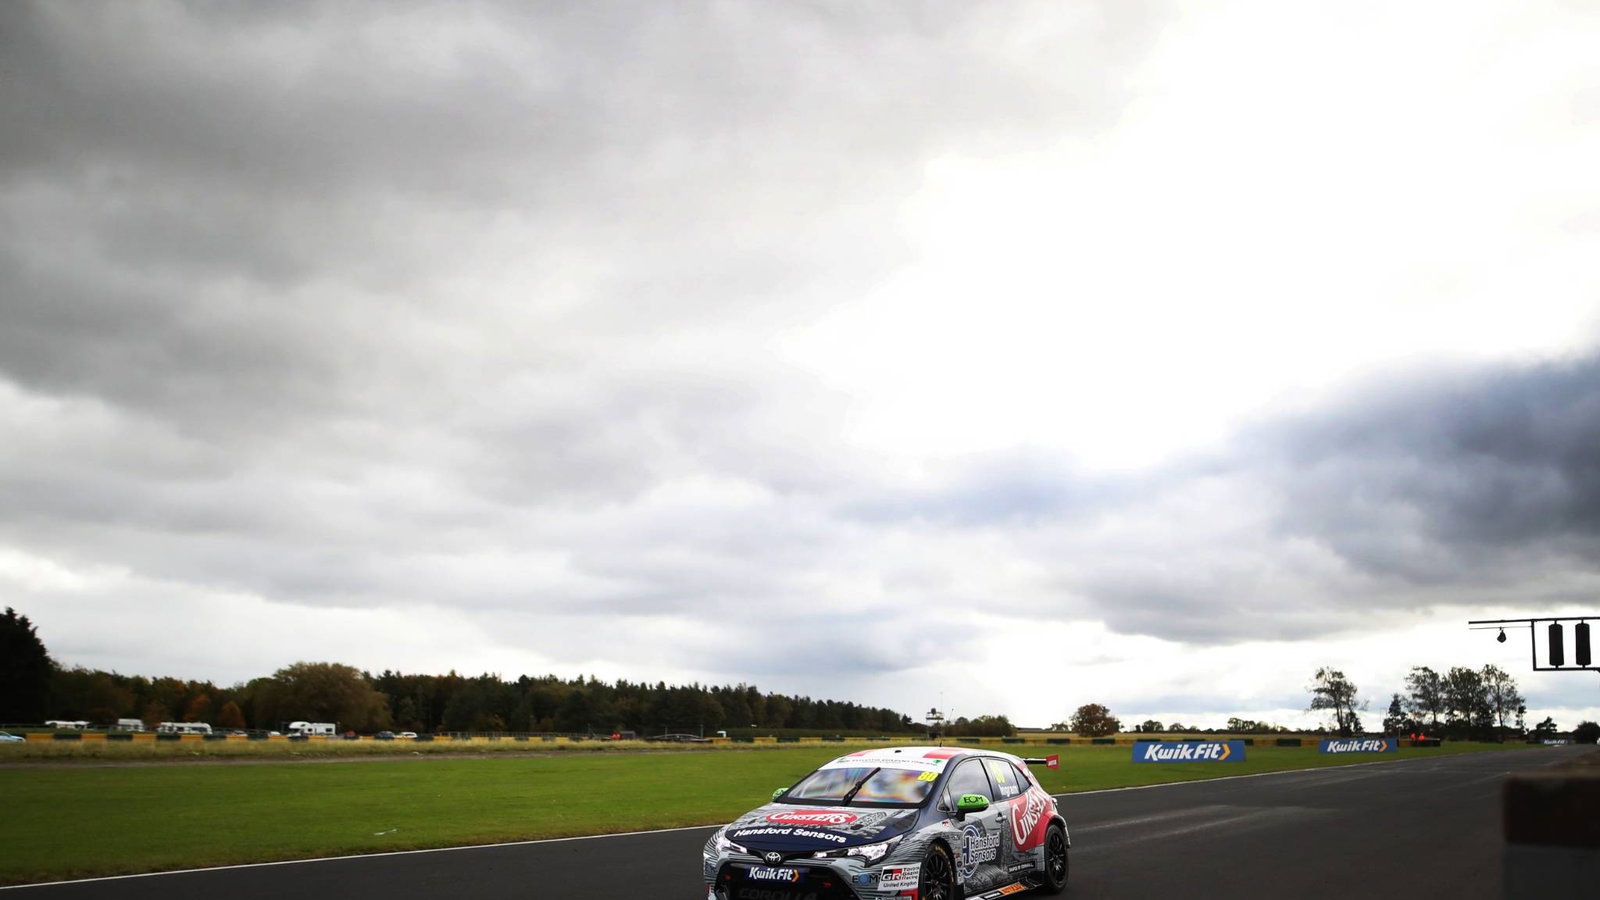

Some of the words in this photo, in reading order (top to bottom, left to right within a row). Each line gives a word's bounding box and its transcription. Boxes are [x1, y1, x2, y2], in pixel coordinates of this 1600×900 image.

[733, 827, 792, 838] Hansford
[793, 828, 847, 843] Sensors
[970, 832, 1000, 849] Hansford
[970, 848, 996, 863] Sensors
[882, 872, 902, 881] GR
